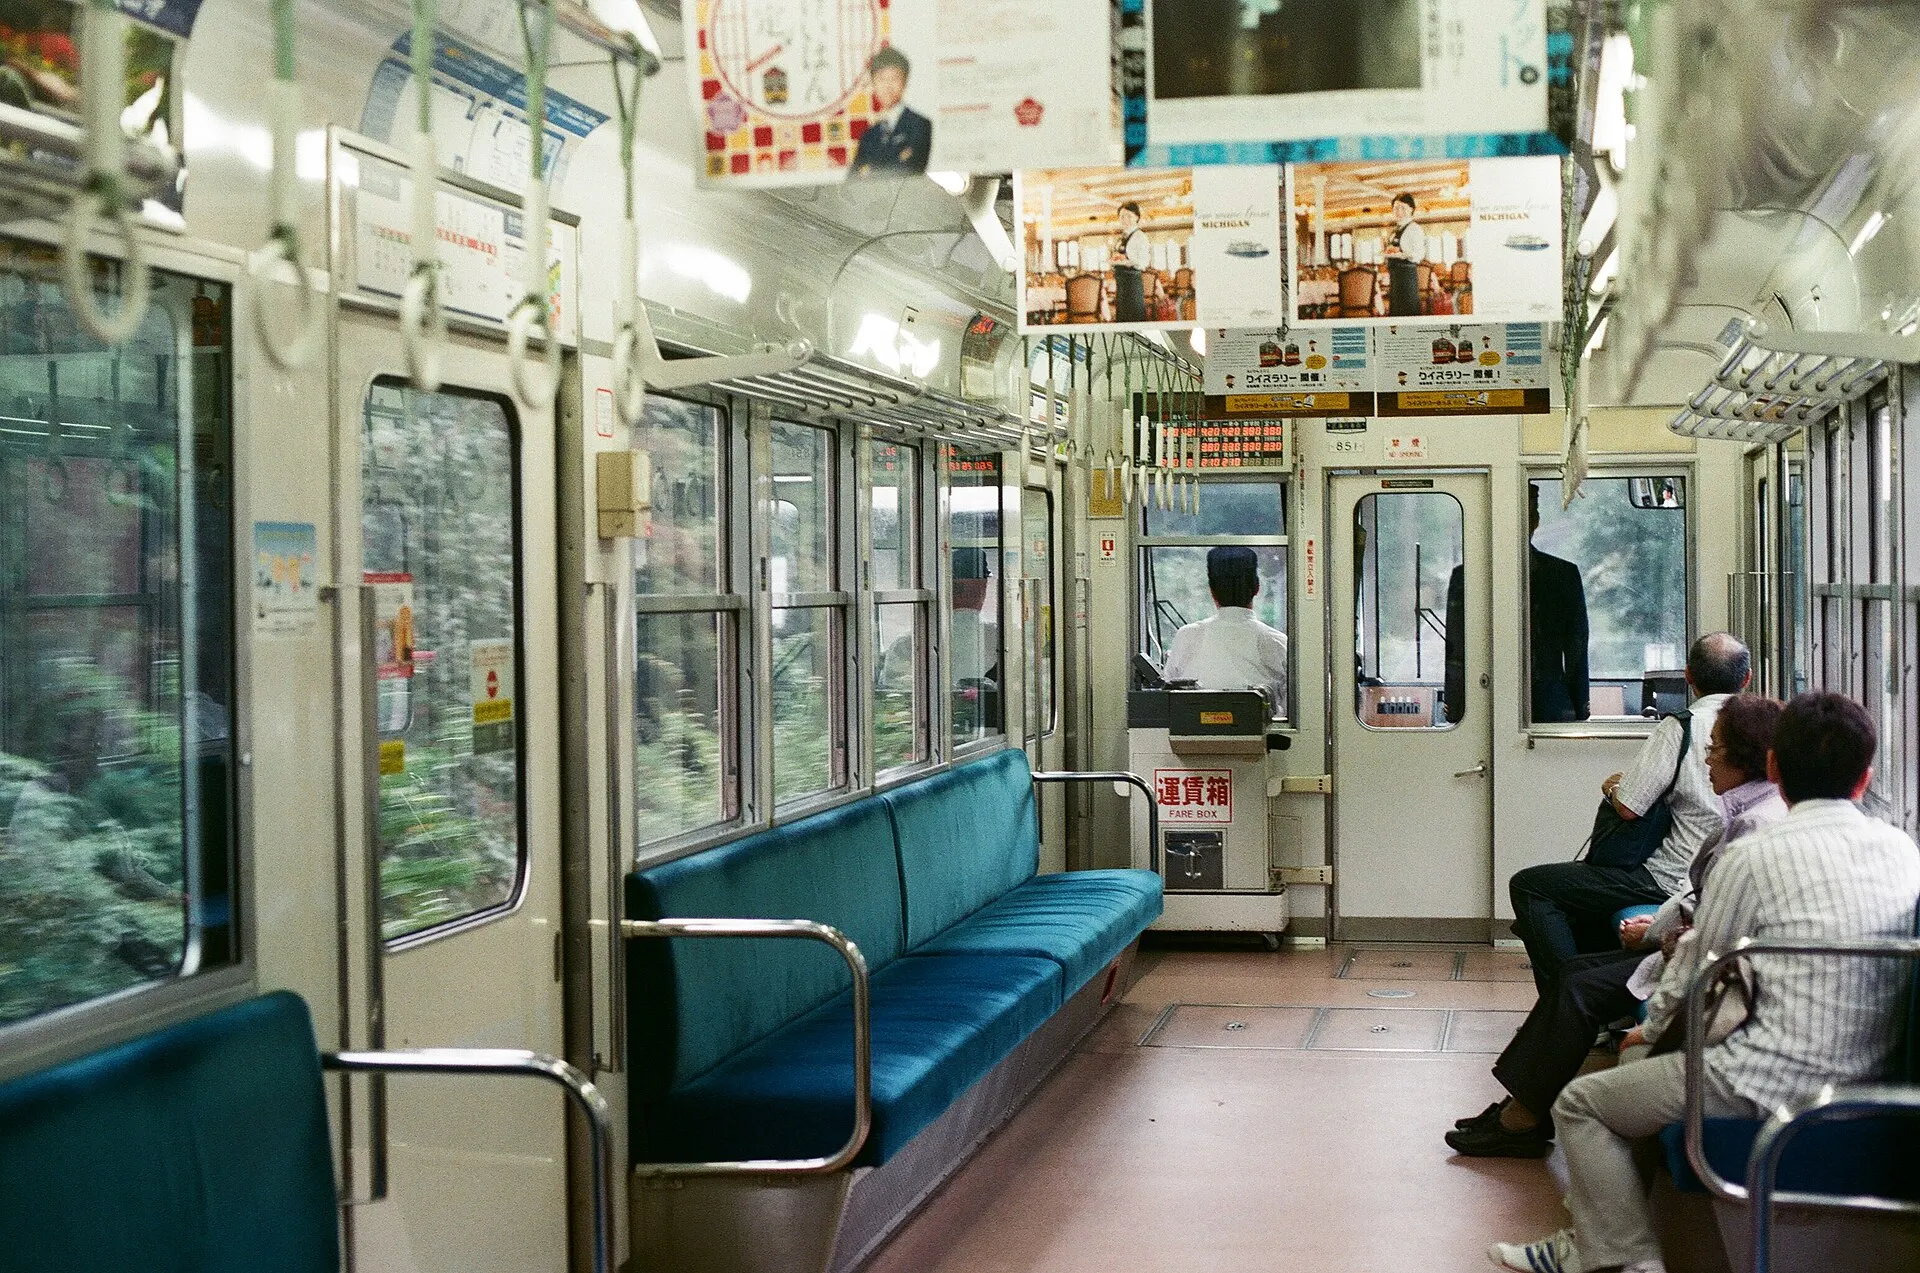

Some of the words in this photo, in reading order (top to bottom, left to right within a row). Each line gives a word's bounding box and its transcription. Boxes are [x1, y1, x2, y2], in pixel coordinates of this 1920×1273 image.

[1479, 212, 1530, 221] MICHIGAN
[1202, 220, 1250, 229] MICHIGAN
[1201, 427, 1220, 437] 420
[1221, 427, 1241, 437] 420
[1263, 442, 1282, 452] 330
[1157, 776, 1229, 806] 運賃箱
[1169, 809, 1193, 819] FARE
[1197, 809, 1217, 819] BOX
